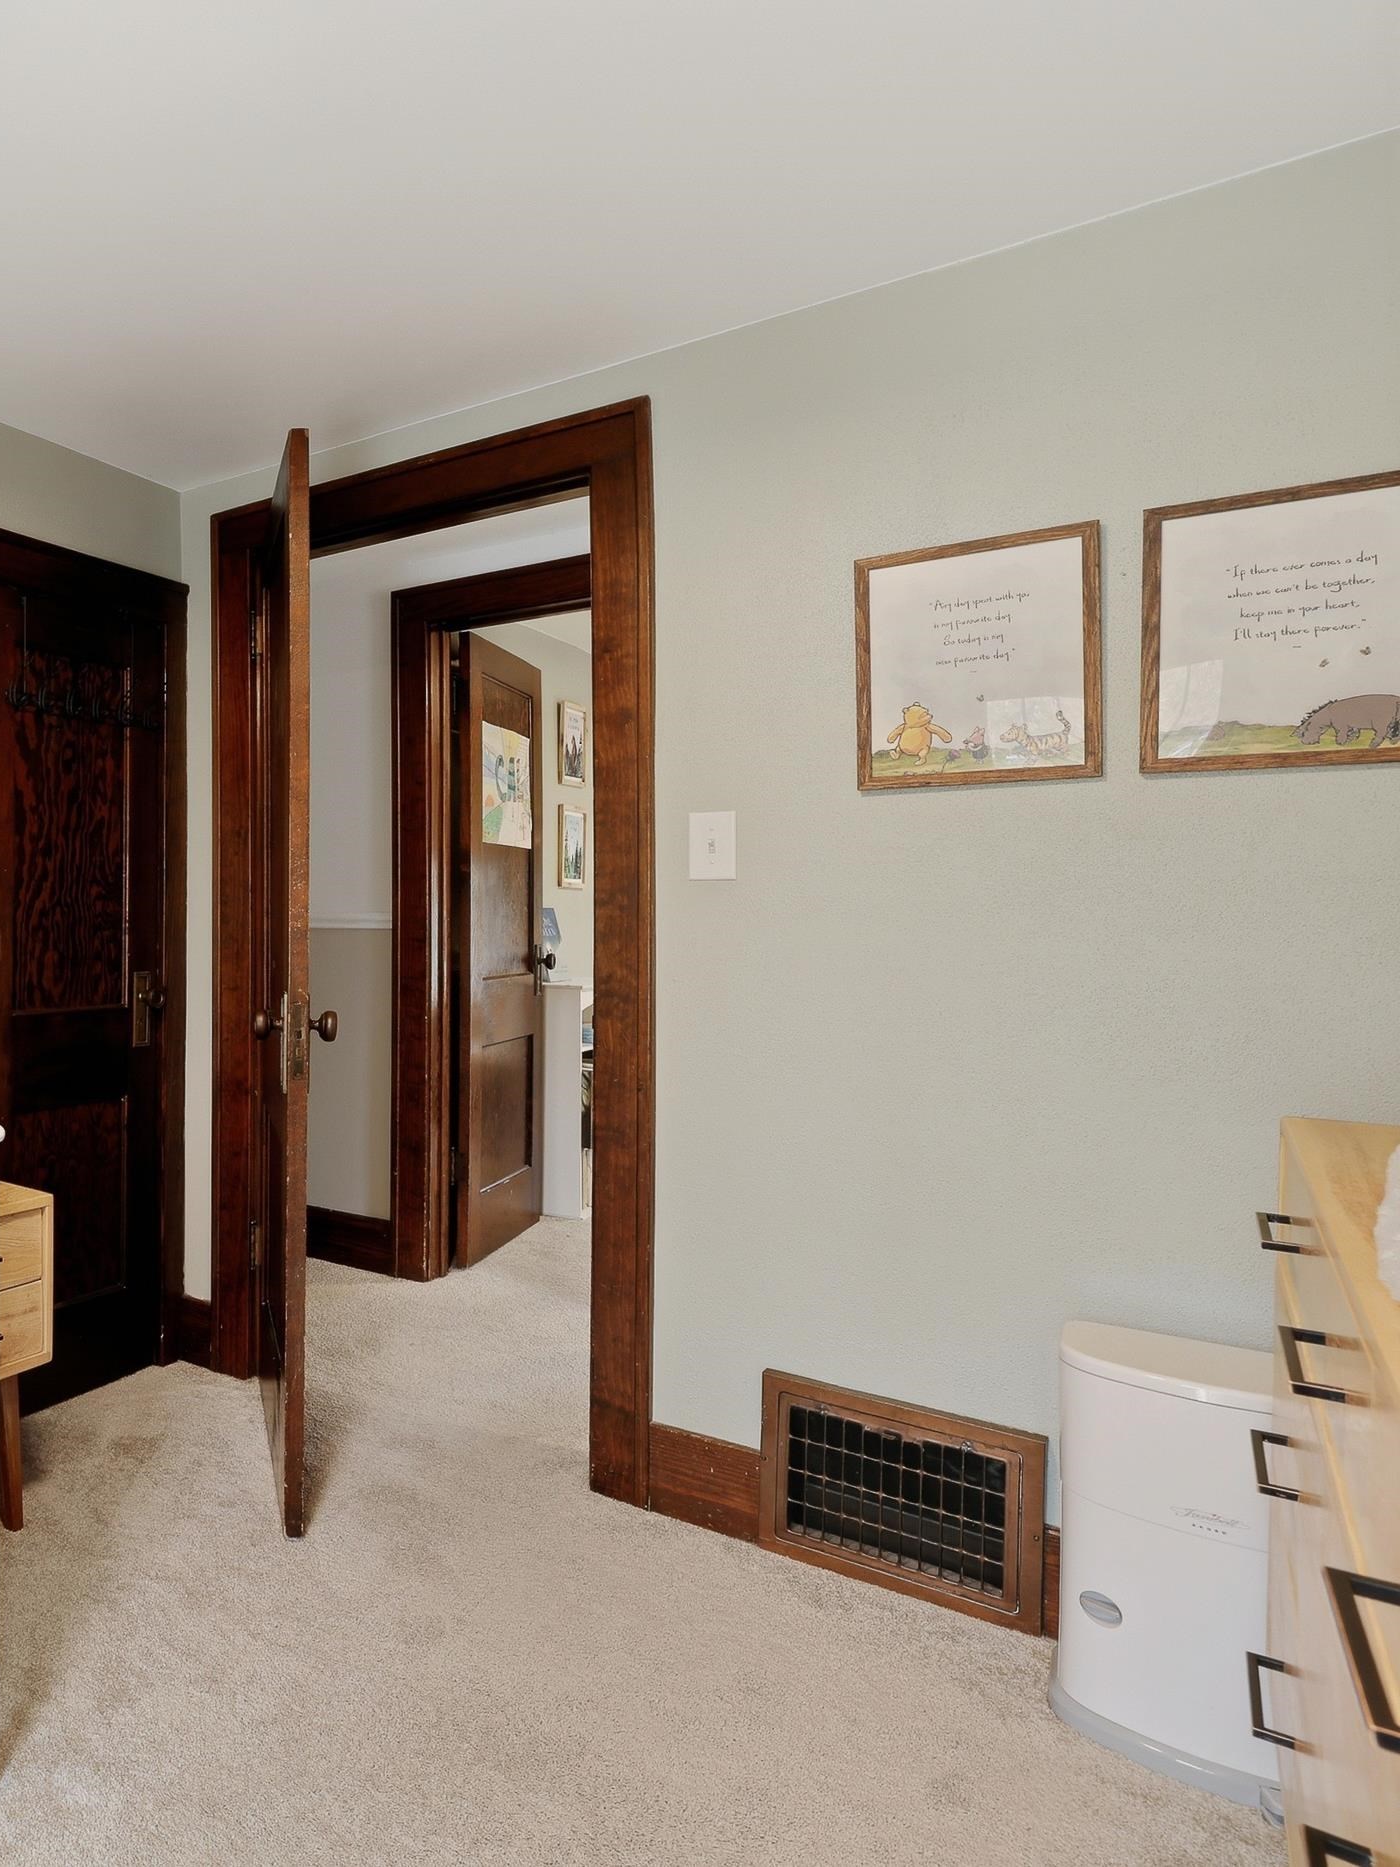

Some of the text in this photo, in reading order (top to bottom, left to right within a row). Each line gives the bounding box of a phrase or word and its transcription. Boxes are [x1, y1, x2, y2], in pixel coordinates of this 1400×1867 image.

[1249, 564, 1279, 575] there
[1282, 563, 1306, 571] ever
[1310, 559, 1341, 568] comes
[1356, 550, 1378, 566] day
[1227, 587, 1253, 599] when
[1275, 584, 1300, 594] can't
[1305, 579, 1319, 590] be
[1322, 574, 1375, 593] together,
[954, 597, 970, 610] day
[972, 596, 992, 609] spent
[995, 590, 1014, 601] with
[1240, 607, 1264, 622] keep
[1287, 606, 1295, 614] in
[1298, 606, 1320, 617] your
[1325, 599, 1360, 610] heart,
[941, 621, 953, 631] my
[1233, 628, 1252, 641] I'll
[1256, 630, 1277, 641] stay
[1281, 625, 1310, 636] there
[958, 633, 981, 646] today
[991, 633, 1004, 643] my
